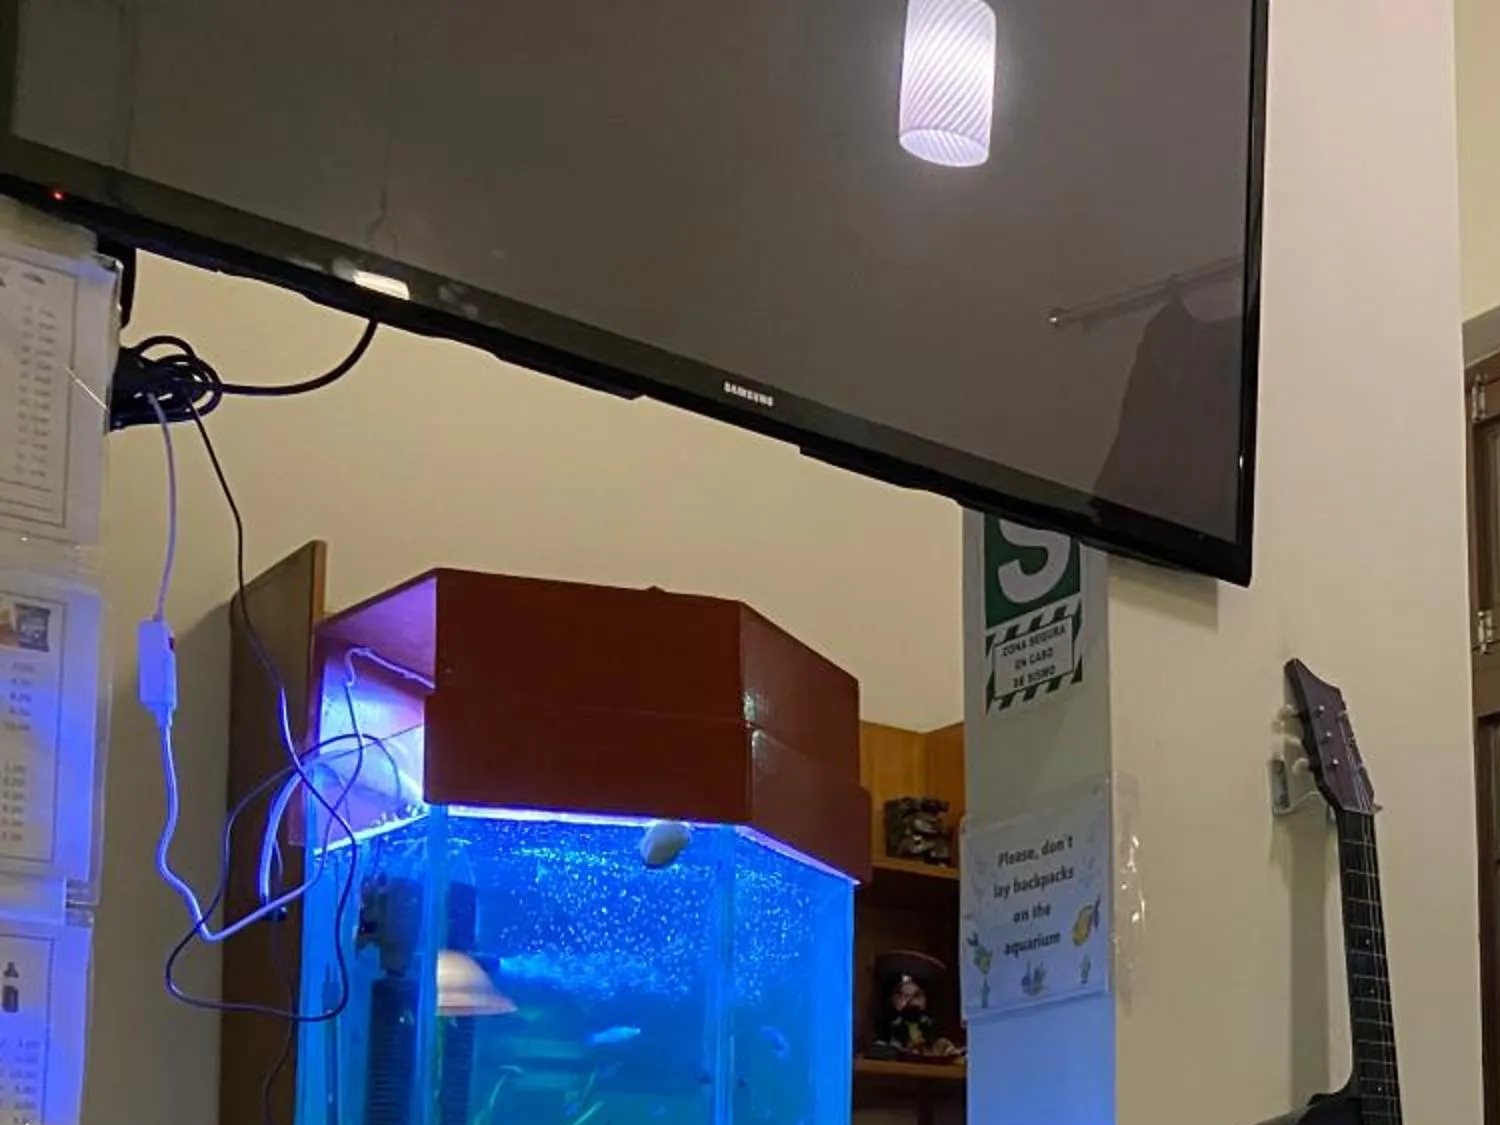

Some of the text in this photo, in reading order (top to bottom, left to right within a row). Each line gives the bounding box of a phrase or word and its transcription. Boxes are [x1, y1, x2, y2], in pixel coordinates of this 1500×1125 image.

[998, 848, 1039, 867] Please,
[1013, 866, 1074, 892] backpacks
[1031, 901, 1052, 919] the
[1005, 932, 1061, 957] aquarium
